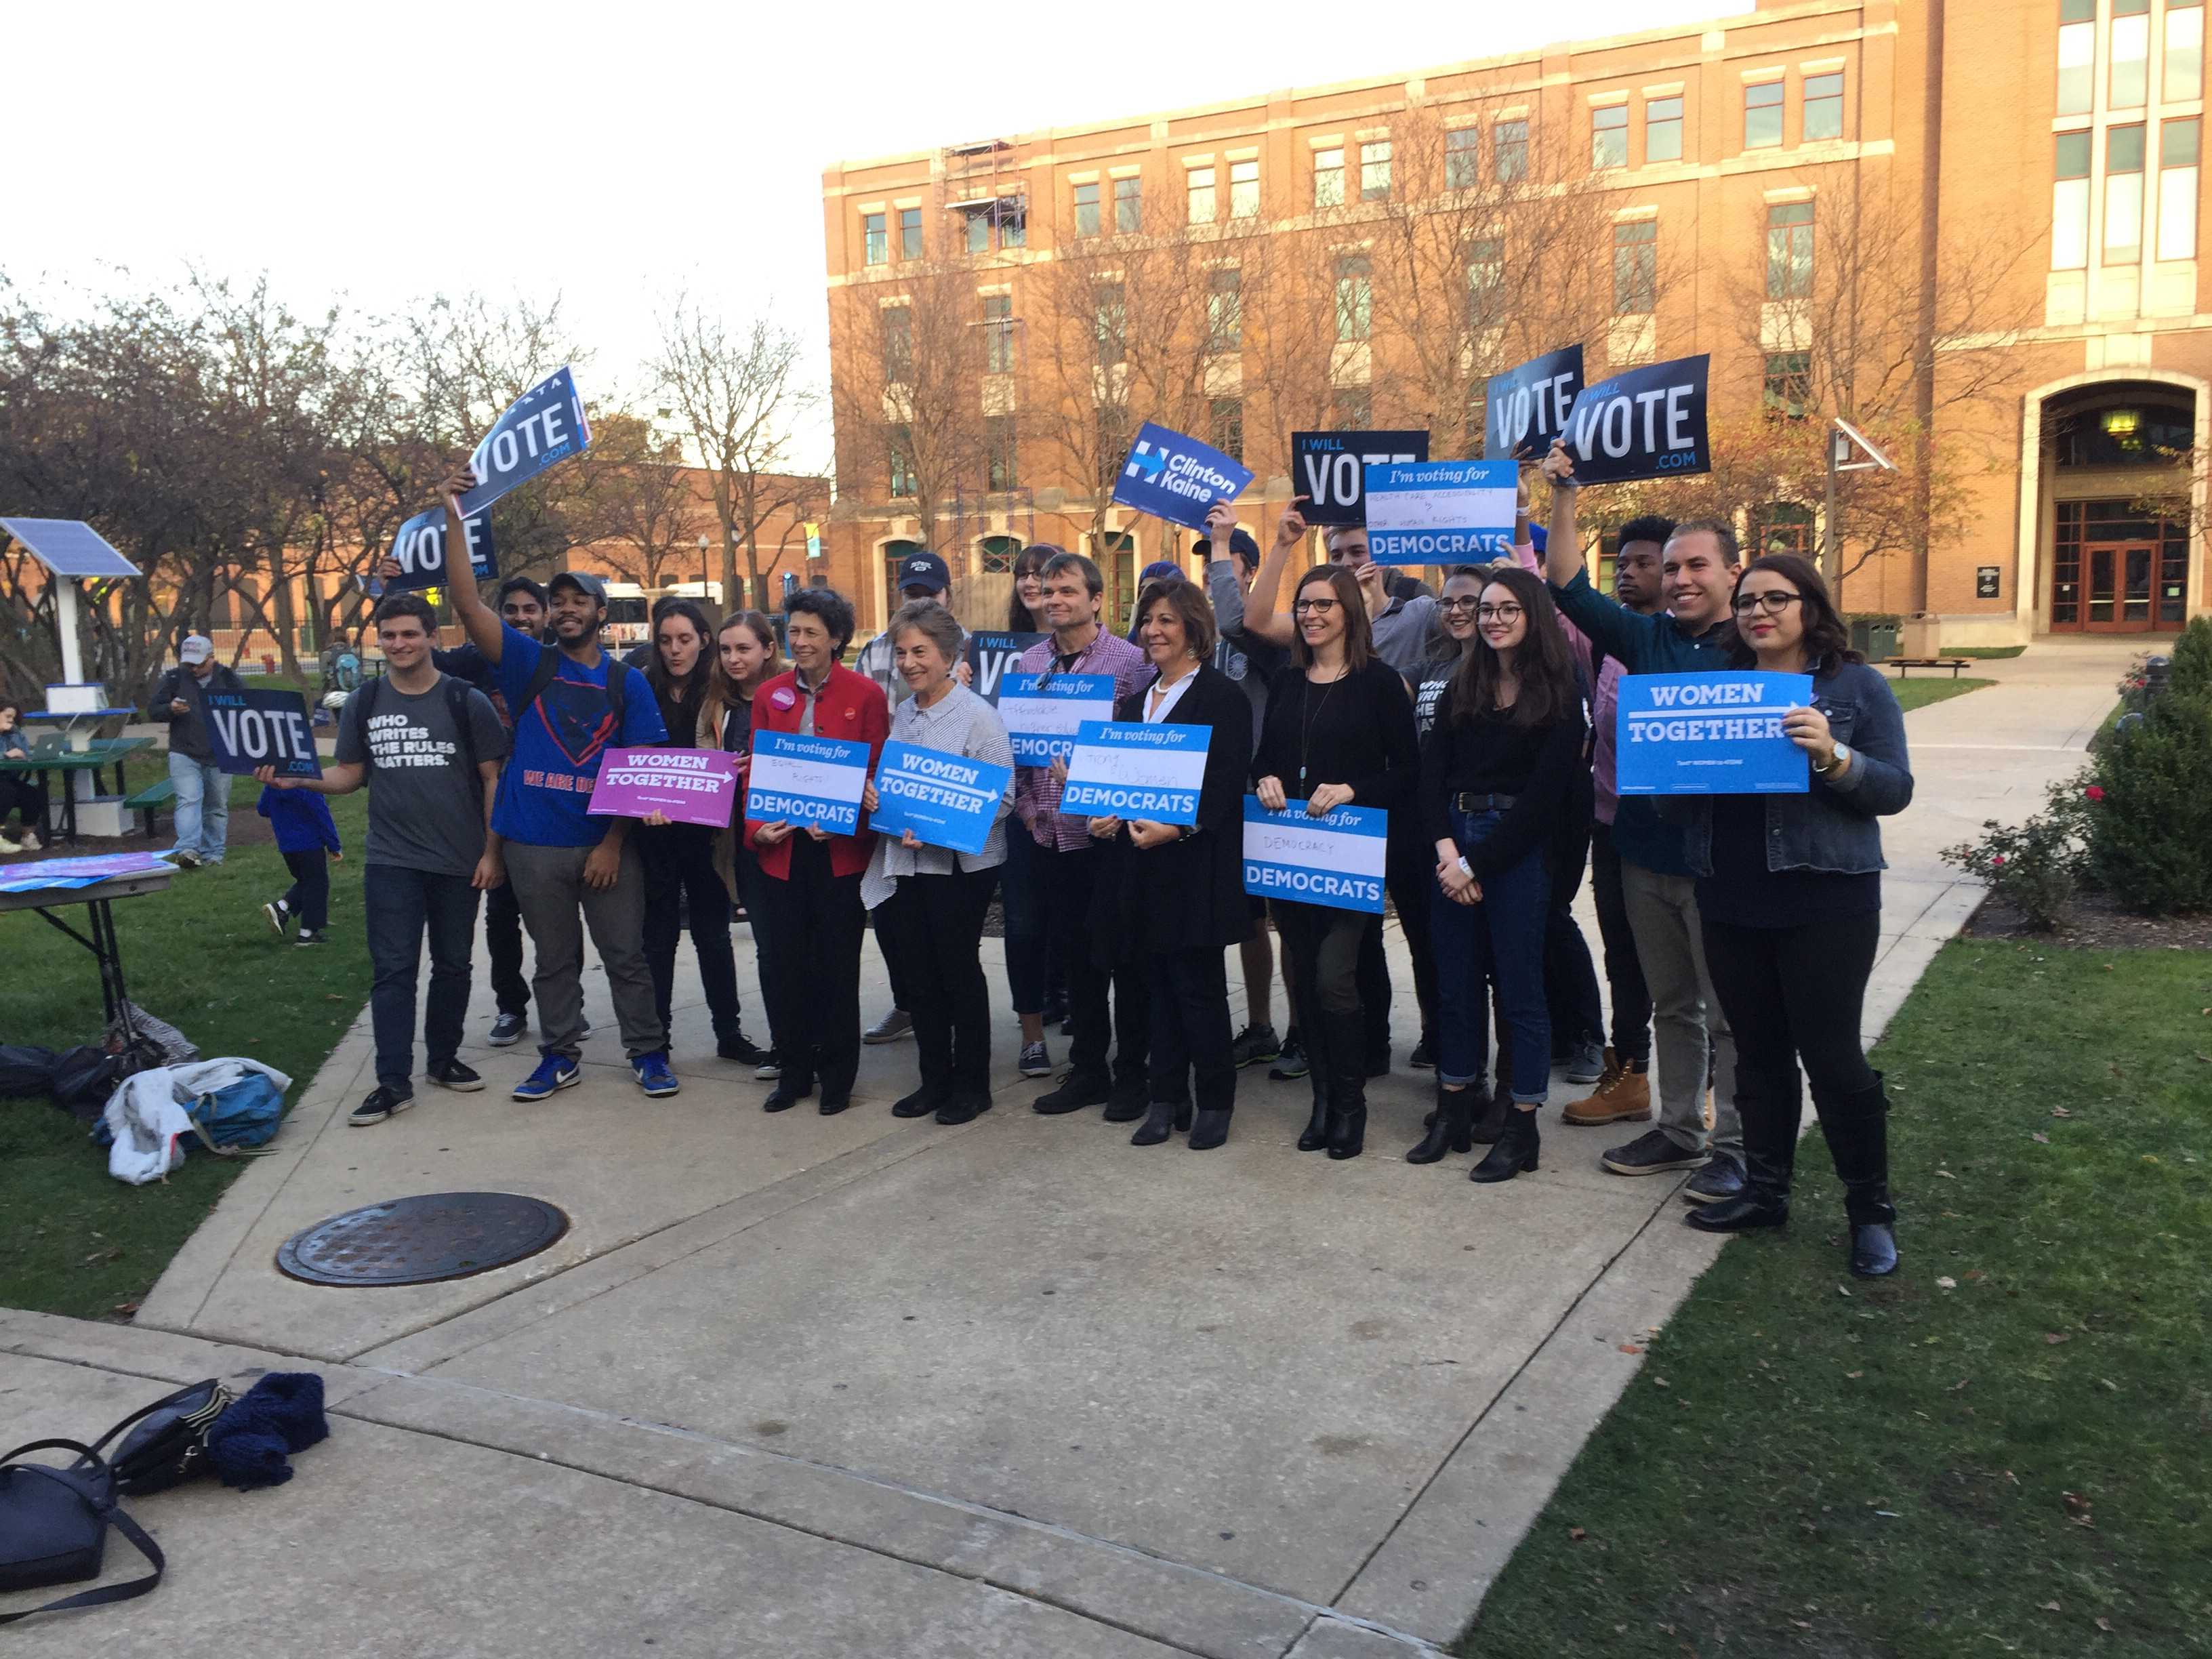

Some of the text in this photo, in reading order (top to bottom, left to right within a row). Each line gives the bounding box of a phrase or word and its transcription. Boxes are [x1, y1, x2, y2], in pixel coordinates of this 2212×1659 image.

[1589, 382, 1621, 402] WILL
[1495, 371, 1574, 449] VOTE
[1574, 384, 1695, 462] VOTE
[469, 401, 569, 487] VOTE
[539, 441, 571, 467] .COM
[1302, 438, 1345, 451] I WILL
[1656, 450, 1696, 470] .COM
[1168, 454, 1237, 495] Clinton
[1389, 466, 1490, 484] I'm voting for
[1160, 470, 1212, 504] Kaine
[398, 517, 487, 573] VOE
[1371, 532, 1510, 555] DEMOCRATS
[986, 638, 1017, 649] WILL
[1044, 678, 1076, 695] oting
[1073, 680, 1095, 695] for
[1650, 682, 1765, 707] WOMEN
[215, 694, 247, 706] WILL
[367, 714, 409, 731] WHO
[1628, 717, 1785, 743] TOGETHER
[211, 709, 312, 760] VOTE
[367, 726, 430, 743] WRITES
[1099, 727, 1187, 745] I'm voting for
[369, 740, 457, 756] THE RULES
[774, 738, 851, 759] I'm voting for
[627, 754, 710, 770] WOMEN
[901, 752, 980, 785] WOMEN
[523, 769, 544, 787] WE
[545, 772, 575, 792] ARE
[606, 773, 720, 794] TOGETHER
[880, 776, 985, 815] TOGETHER
[1065, 786, 1195, 813] DEMOCRATS
[749, 793, 857, 825] DEMOCRATS
[1336, 811, 1363, 827] for
[1246, 865, 1380, 901] DEMOCRATS
